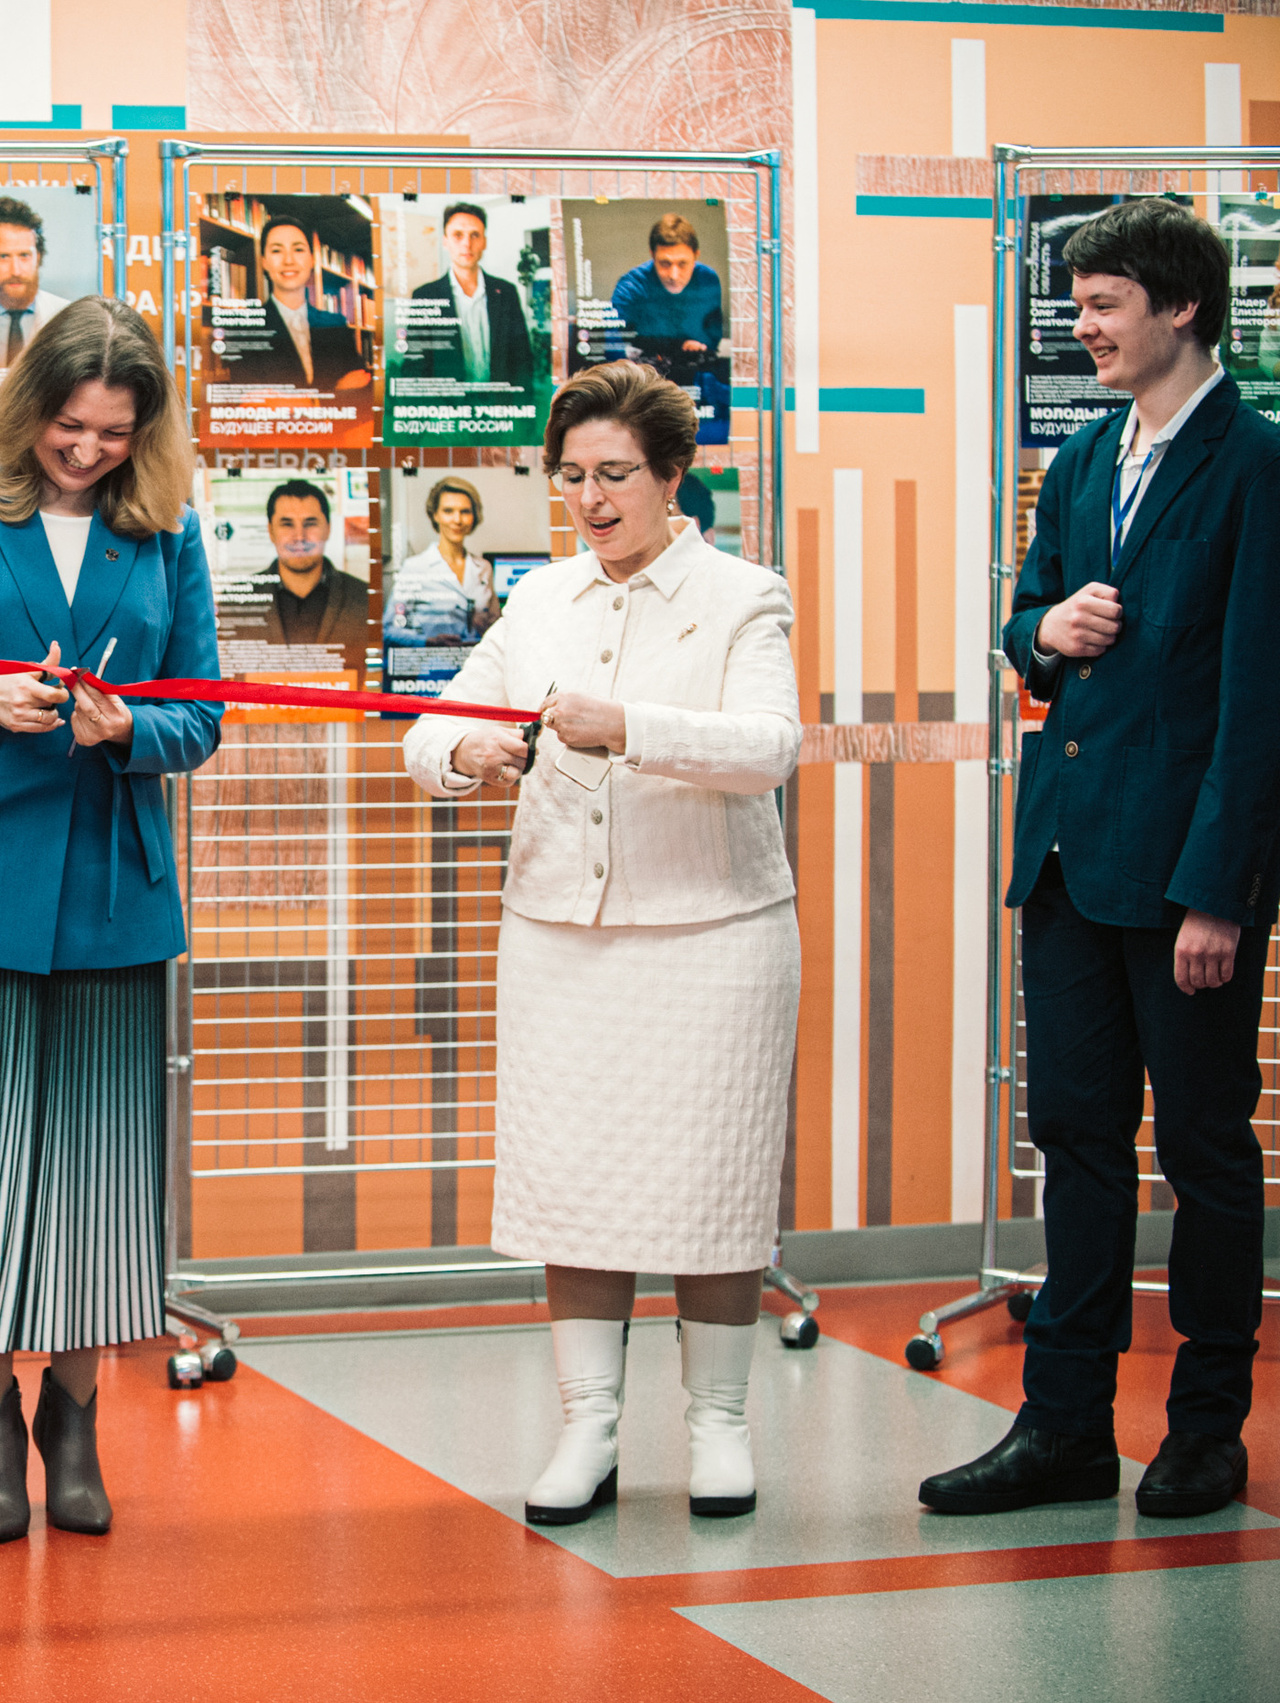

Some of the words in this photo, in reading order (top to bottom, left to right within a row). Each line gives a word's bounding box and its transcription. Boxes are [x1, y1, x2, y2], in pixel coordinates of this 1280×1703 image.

[1231, 297, 1267, 308] Лидер
[1030, 307, 1057, 317] Олег
[210, 407, 290, 420] МОЛОДЫЕ
[293, 406, 357, 420] УЧЕНЫЕ
[393, 406, 472, 420] МОЛОДЫЕ
[474, 405, 536, 418] УЧЕНЫЕ
[210, 421, 274, 436] БУДУЩЕЕ
[276, 421, 333, 434] РОССИИ
[393, 420, 455, 434] БУДУЩЕЕ
[458, 420, 513, 433] РОССИИ
